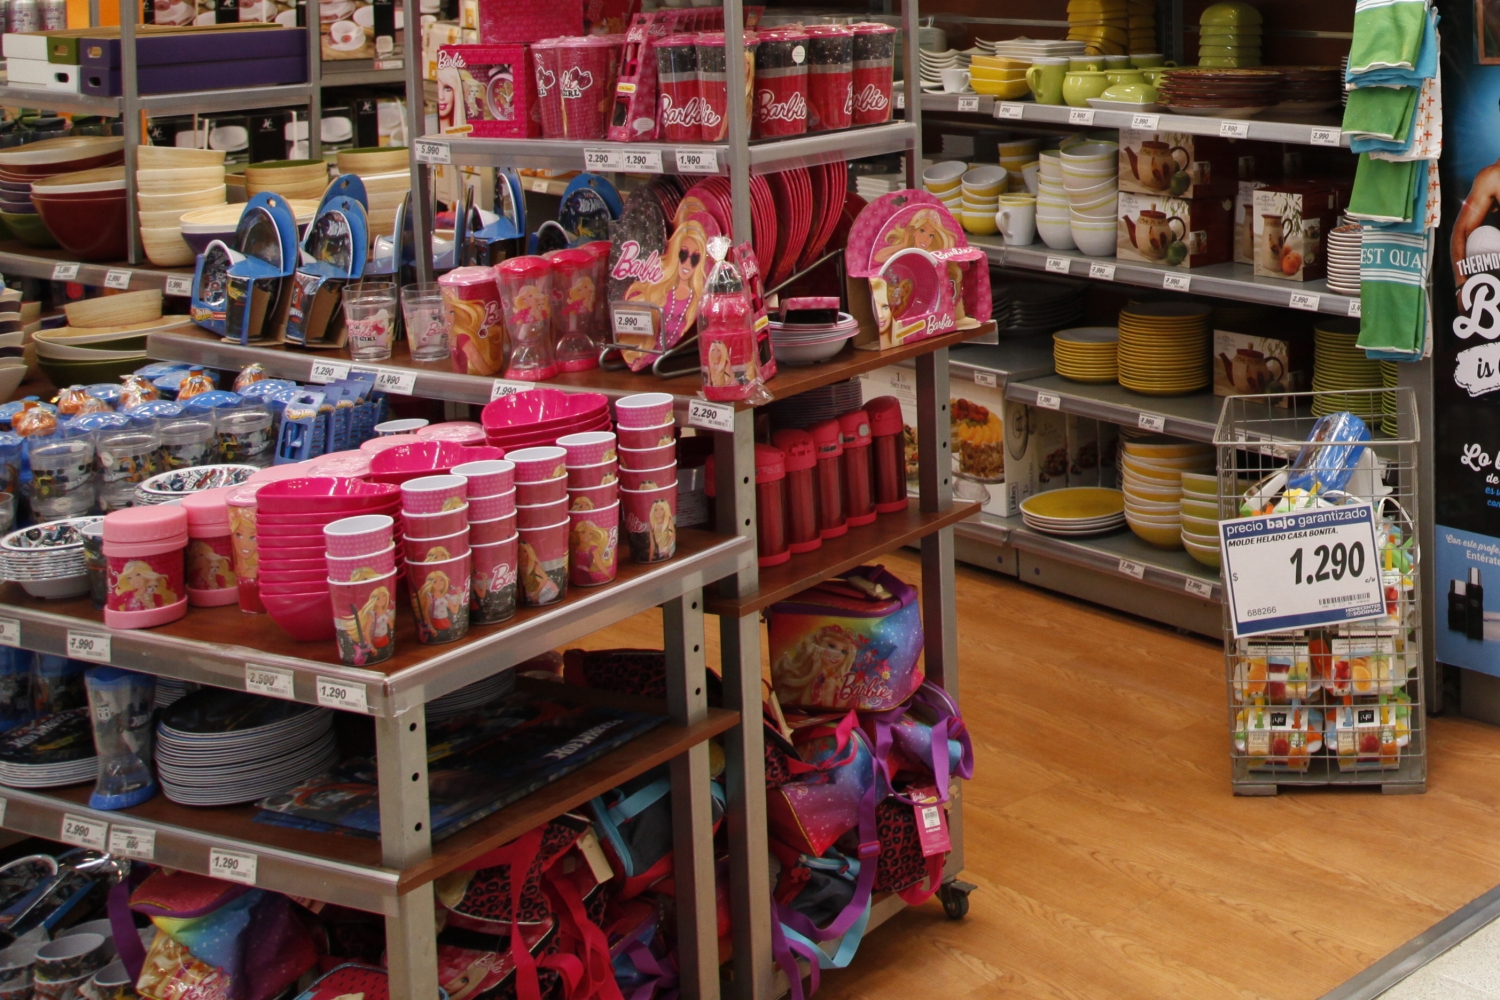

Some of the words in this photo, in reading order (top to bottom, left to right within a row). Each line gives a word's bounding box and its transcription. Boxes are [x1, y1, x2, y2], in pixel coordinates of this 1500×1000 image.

[437, 50, 466, 70] Barbie
[757, 89, 808, 122] Barbie
[1313, 131, 1330, 140] 2.990
[421, 146, 440, 155] 5.990
[588, 154, 609, 163] 2.290
[626, 155, 647, 165] 1.290
[679, 155, 701, 165] 1.490
[611, 240, 664, 284] Barbie
[618, 317, 638, 326] 2.990
[927, 313, 955, 335] Barbie
[314, 366, 334, 376] 1.290
[1476, 357, 1494, 379] is
[379, 374, 401, 385] 1.490
[692, 406, 717, 420] 2.290
[1461, 443, 1492, 472] Lo
[1486, 473, 1499, 485] de
[1226, 521, 1264, 537] precio
[1266, 516, 1296, 530] bajo
[1298, 507, 1368, 527] garantizado
[1228, 535, 1255, 547] MOLDE
[1256, 533, 1286, 544] HELADO
[1287, 530, 1308, 540] CASA
[1308, 527, 1339, 537] BONITA.
[1446, 534, 1461, 546] Con
[1462, 538, 1477, 549] este
[1289, 540, 1365, 585] 1.290
[1247, 606, 1277, 617] 688266
[70, 638, 94, 650] 7.990
[321, 685, 347, 700] 1.290
[837, 672, 892, 701] Barbie
[65, 824, 90, 837] 2.990
[213, 856, 239, 870] 1.290
